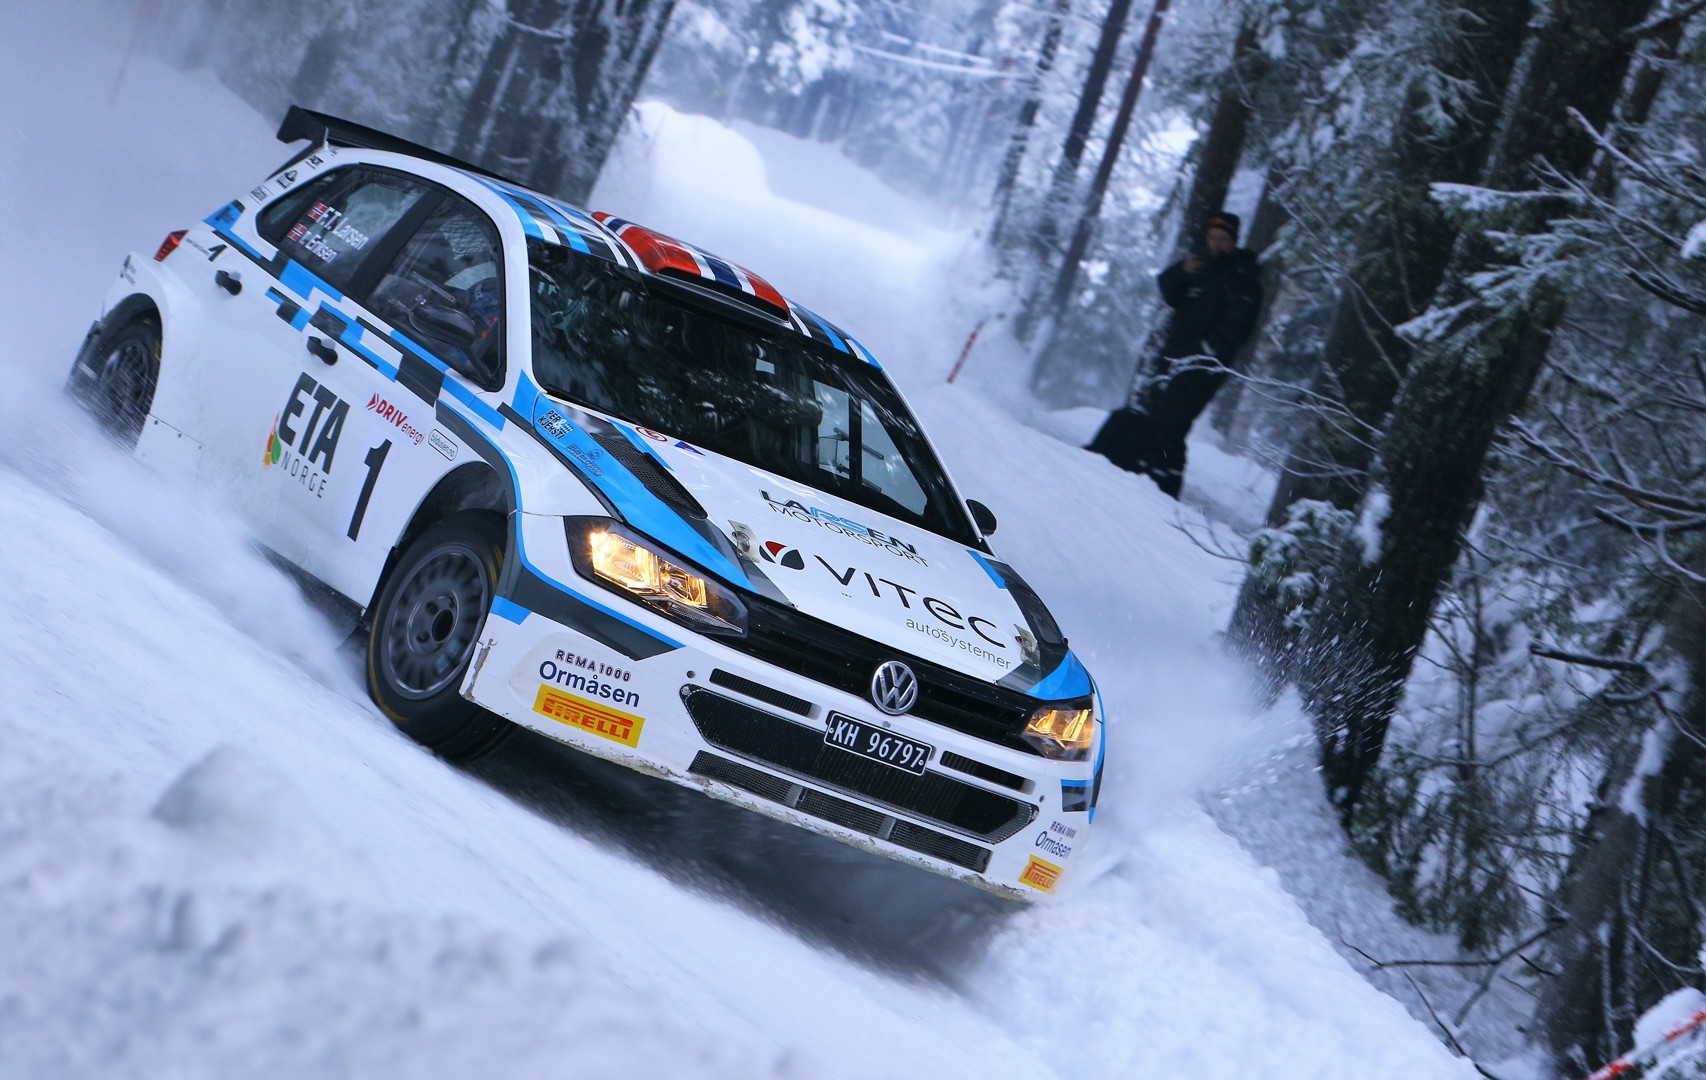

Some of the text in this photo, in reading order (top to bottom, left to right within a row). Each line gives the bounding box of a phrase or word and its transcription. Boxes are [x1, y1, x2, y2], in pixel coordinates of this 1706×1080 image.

[331, 217, 369, 251] Larsen
[278, 371, 351, 475] ETA
[545, 409, 562, 424] PER
[280, 450, 328, 500] NORGE
[346, 438, 393, 542] 1
[758, 489, 919, 555] LARSEN
[768, 502, 929, 567] MOTORSPORT
[555, 648, 632, 682] REMA 1000
[905, 617, 1012, 670] autosystemer
[539, 660, 641, 708] Ormåsen
[542, 692, 634, 740] PIRELLI
[832, 719, 925, 768] KH 96797
[1034, 830, 1072, 860] Ormåsen
